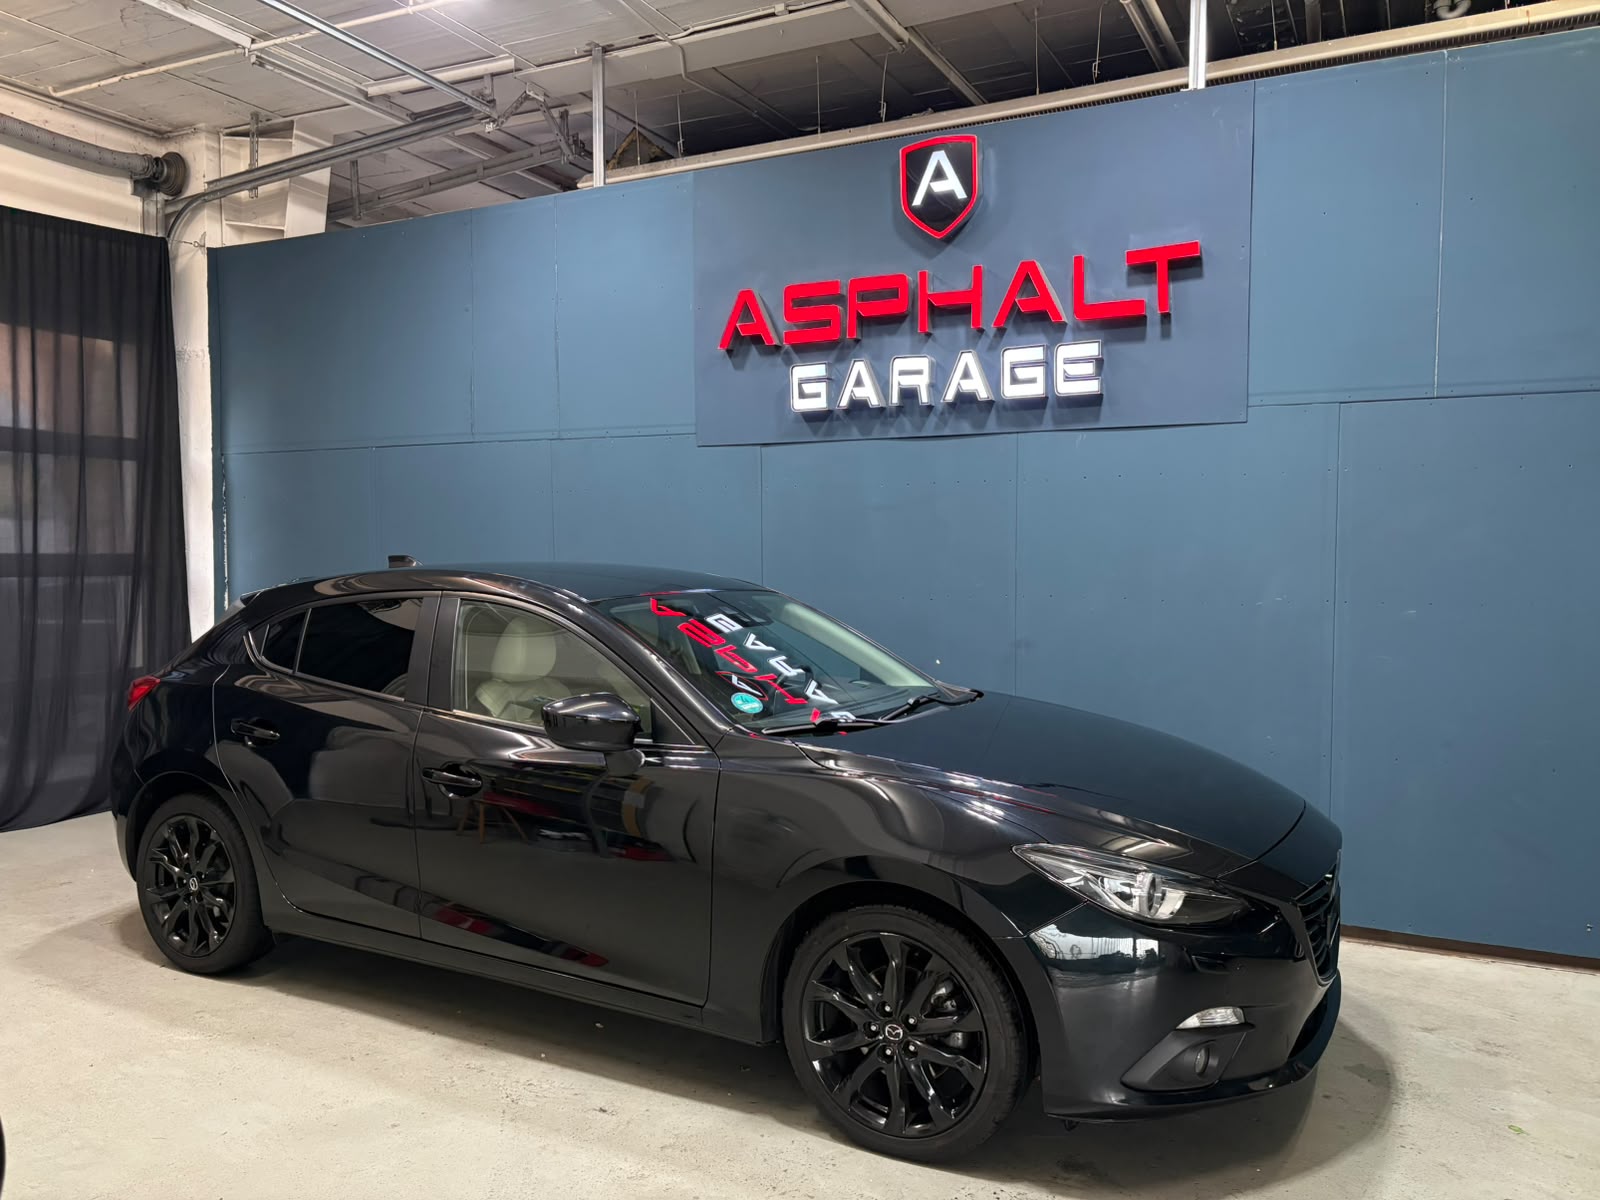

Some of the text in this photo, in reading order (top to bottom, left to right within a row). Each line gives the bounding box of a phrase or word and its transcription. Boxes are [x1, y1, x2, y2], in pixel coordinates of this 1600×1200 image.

[912, 150, 967, 206] A
[718, 240, 1200, 350] ASPHALT
[790, 340, 1103, 413] GARAGE
